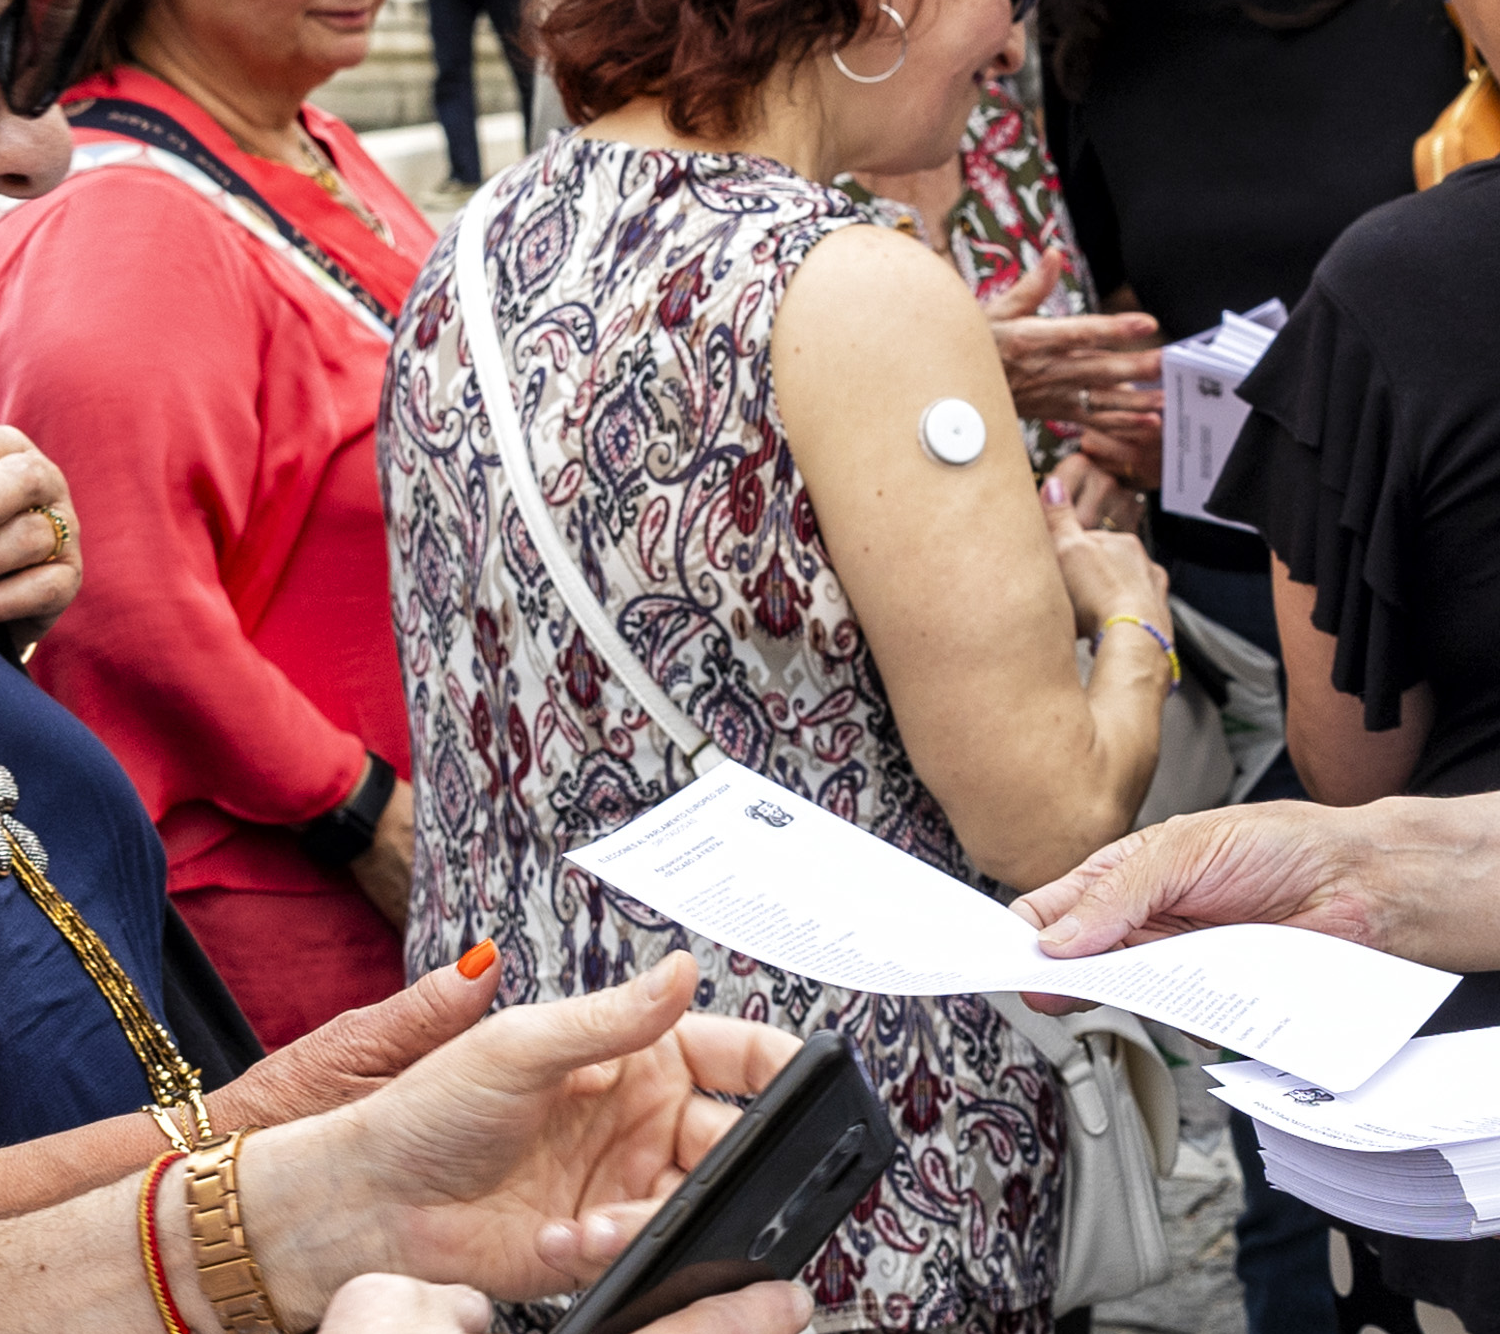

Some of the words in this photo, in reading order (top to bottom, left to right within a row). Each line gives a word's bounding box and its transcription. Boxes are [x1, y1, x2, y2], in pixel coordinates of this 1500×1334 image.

[644, 812, 689, 840] PARLAMENTO
[685, 793, 717, 815] EUROPEO
[715, 783, 731, 796] 2024
